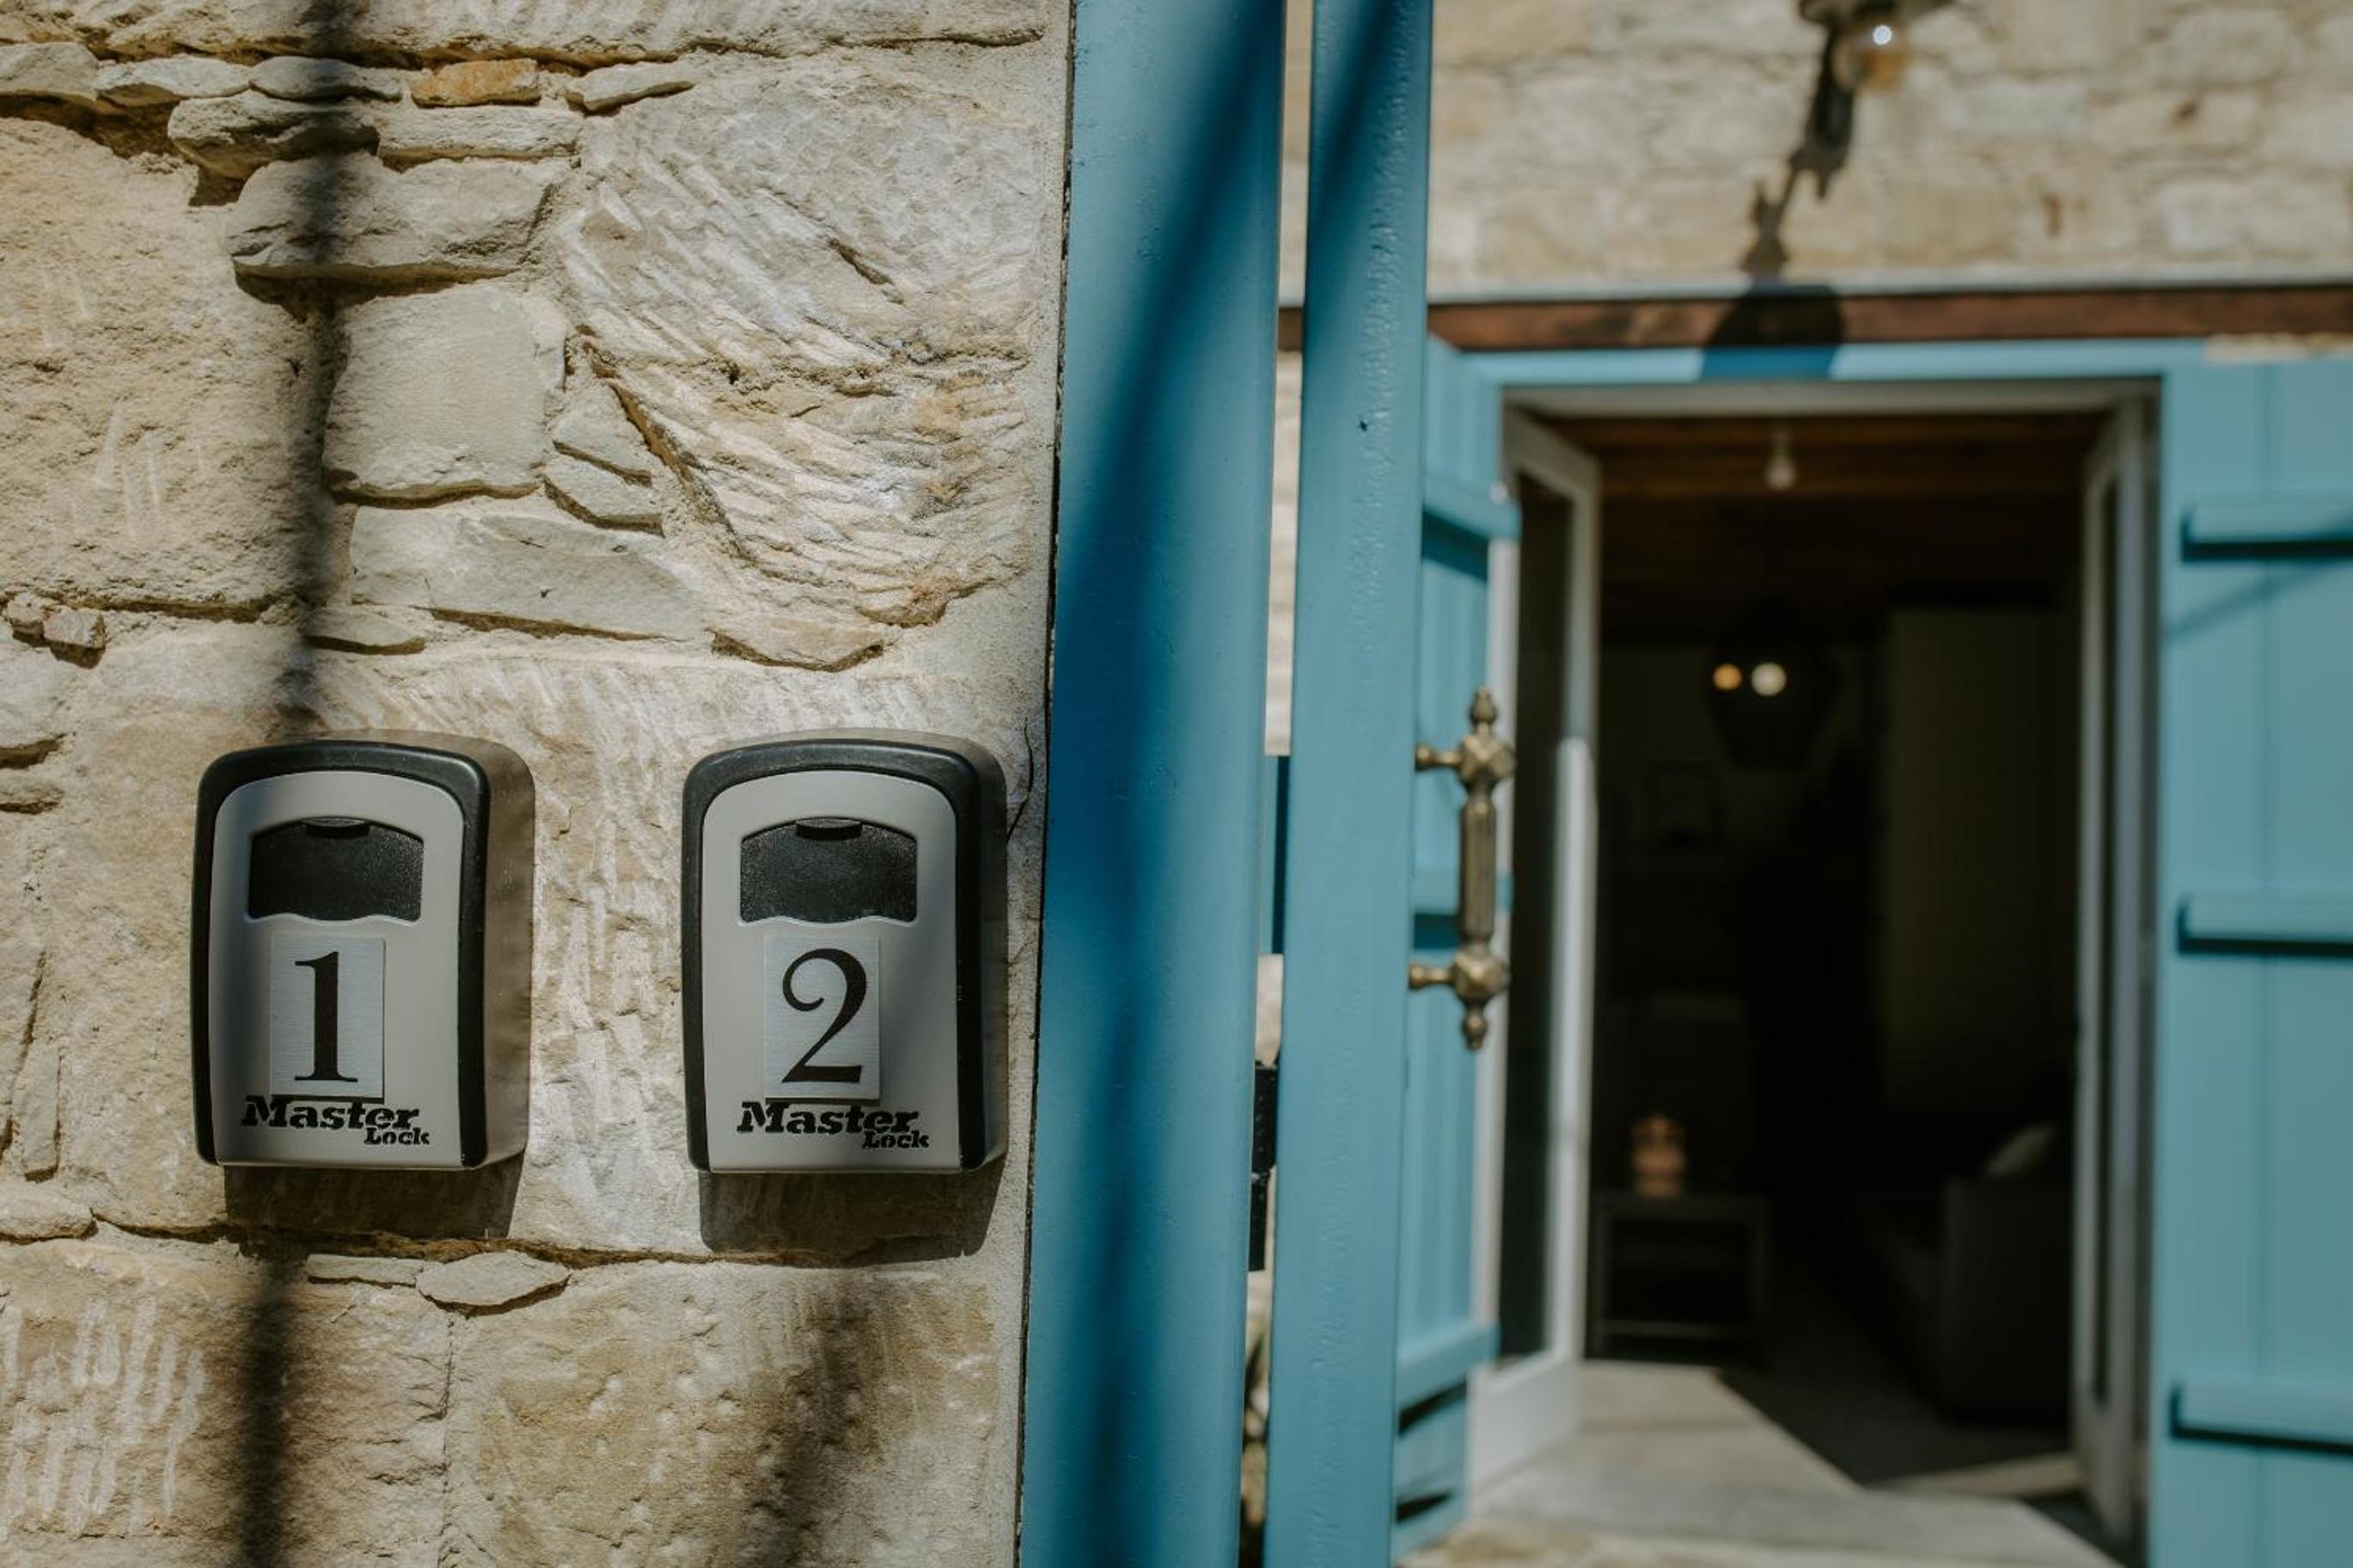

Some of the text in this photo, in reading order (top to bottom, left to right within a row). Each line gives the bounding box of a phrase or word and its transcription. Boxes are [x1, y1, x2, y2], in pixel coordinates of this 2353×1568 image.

[295, 951, 358, 1082] 1
[780, 948, 867, 1083] 2
[241, 1095, 419, 1131] Master
[736, 1101, 920, 1135] Master
[364, 1127, 430, 1145] Lock
[861, 1131, 929, 1150] Lock
